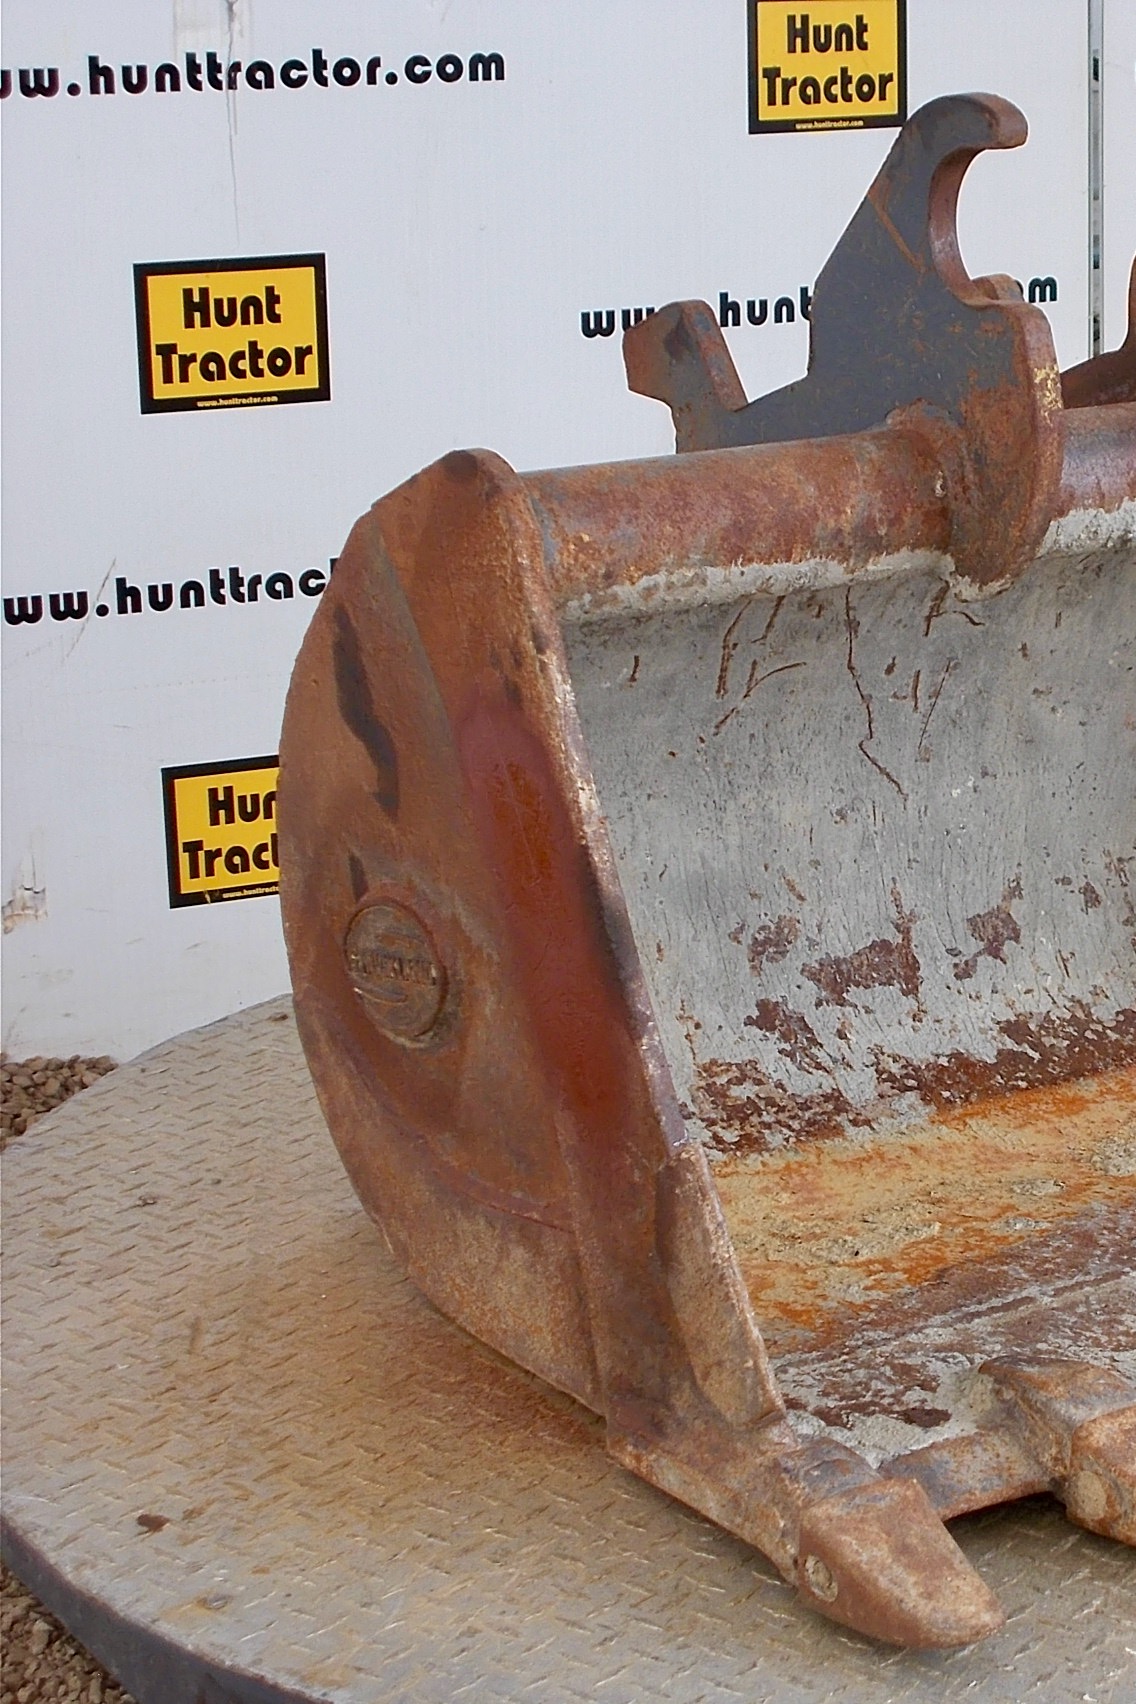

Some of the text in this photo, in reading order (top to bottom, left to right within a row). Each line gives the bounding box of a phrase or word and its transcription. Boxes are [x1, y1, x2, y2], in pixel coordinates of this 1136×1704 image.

[786, 13, 869, 54] Hunt
[0, 47, 505, 101] w.hunttractor.com
[761, 65, 894, 107] Tractor
[182, 284, 282, 329] Hunt
[155, 339, 313, 384] Tractor
[2, 557, 341, 627] ww.hunttrac
